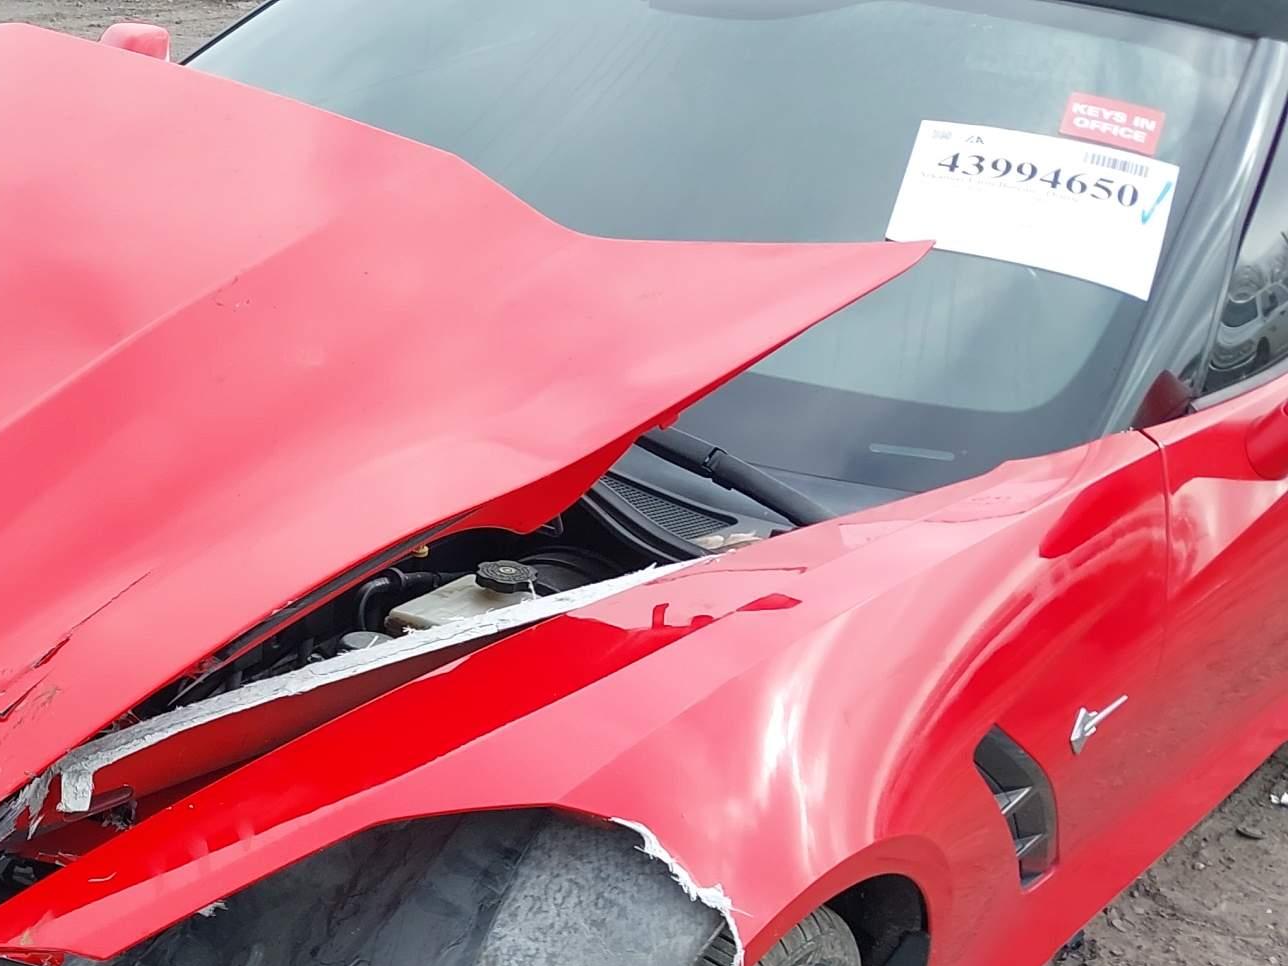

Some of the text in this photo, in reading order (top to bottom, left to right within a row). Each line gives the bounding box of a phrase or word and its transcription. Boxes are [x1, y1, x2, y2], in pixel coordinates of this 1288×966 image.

[1072, 102, 1156, 132] KEYS IN
[1072, 116, 1147, 143] OFFICE
[937, 152, 1139, 208] 43994650
